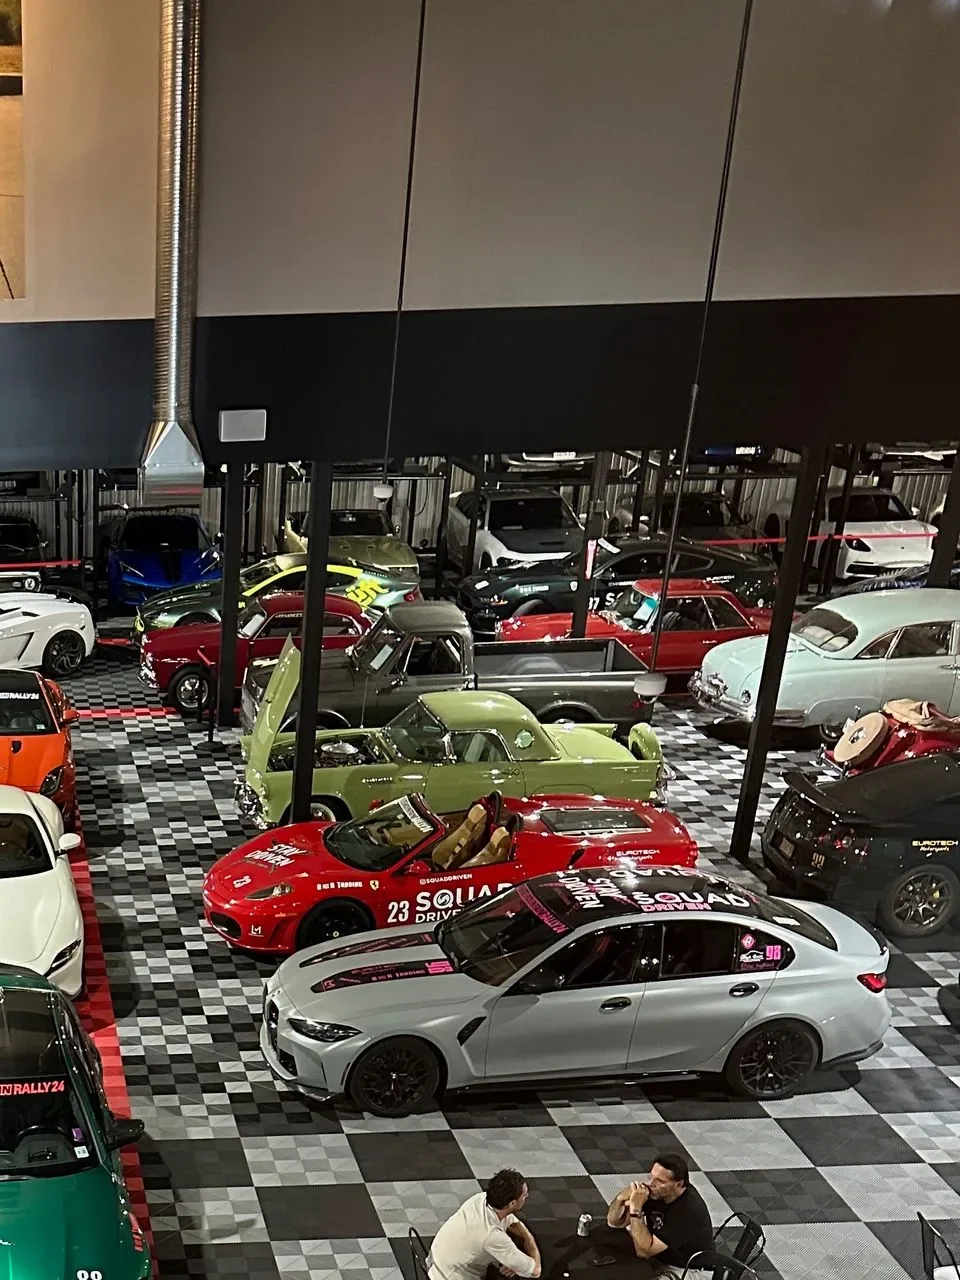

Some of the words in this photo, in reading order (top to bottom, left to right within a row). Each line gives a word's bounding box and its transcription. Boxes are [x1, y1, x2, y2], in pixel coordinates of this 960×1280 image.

[269, 843, 307, 856] STAY
[616, 849, 660, 857] EUROTECH
[244, 849, 295, 867] DRIVEN
[233, 875, 252, 888] 23
[633, 891, 751, 909] SQUAD
[641, 902, 713, 912] DRIVEN
[387, 901, 410, 923] 23
[765, 945, 782, 961] 98
[13, 1080, 65, 1096] RALLY24
